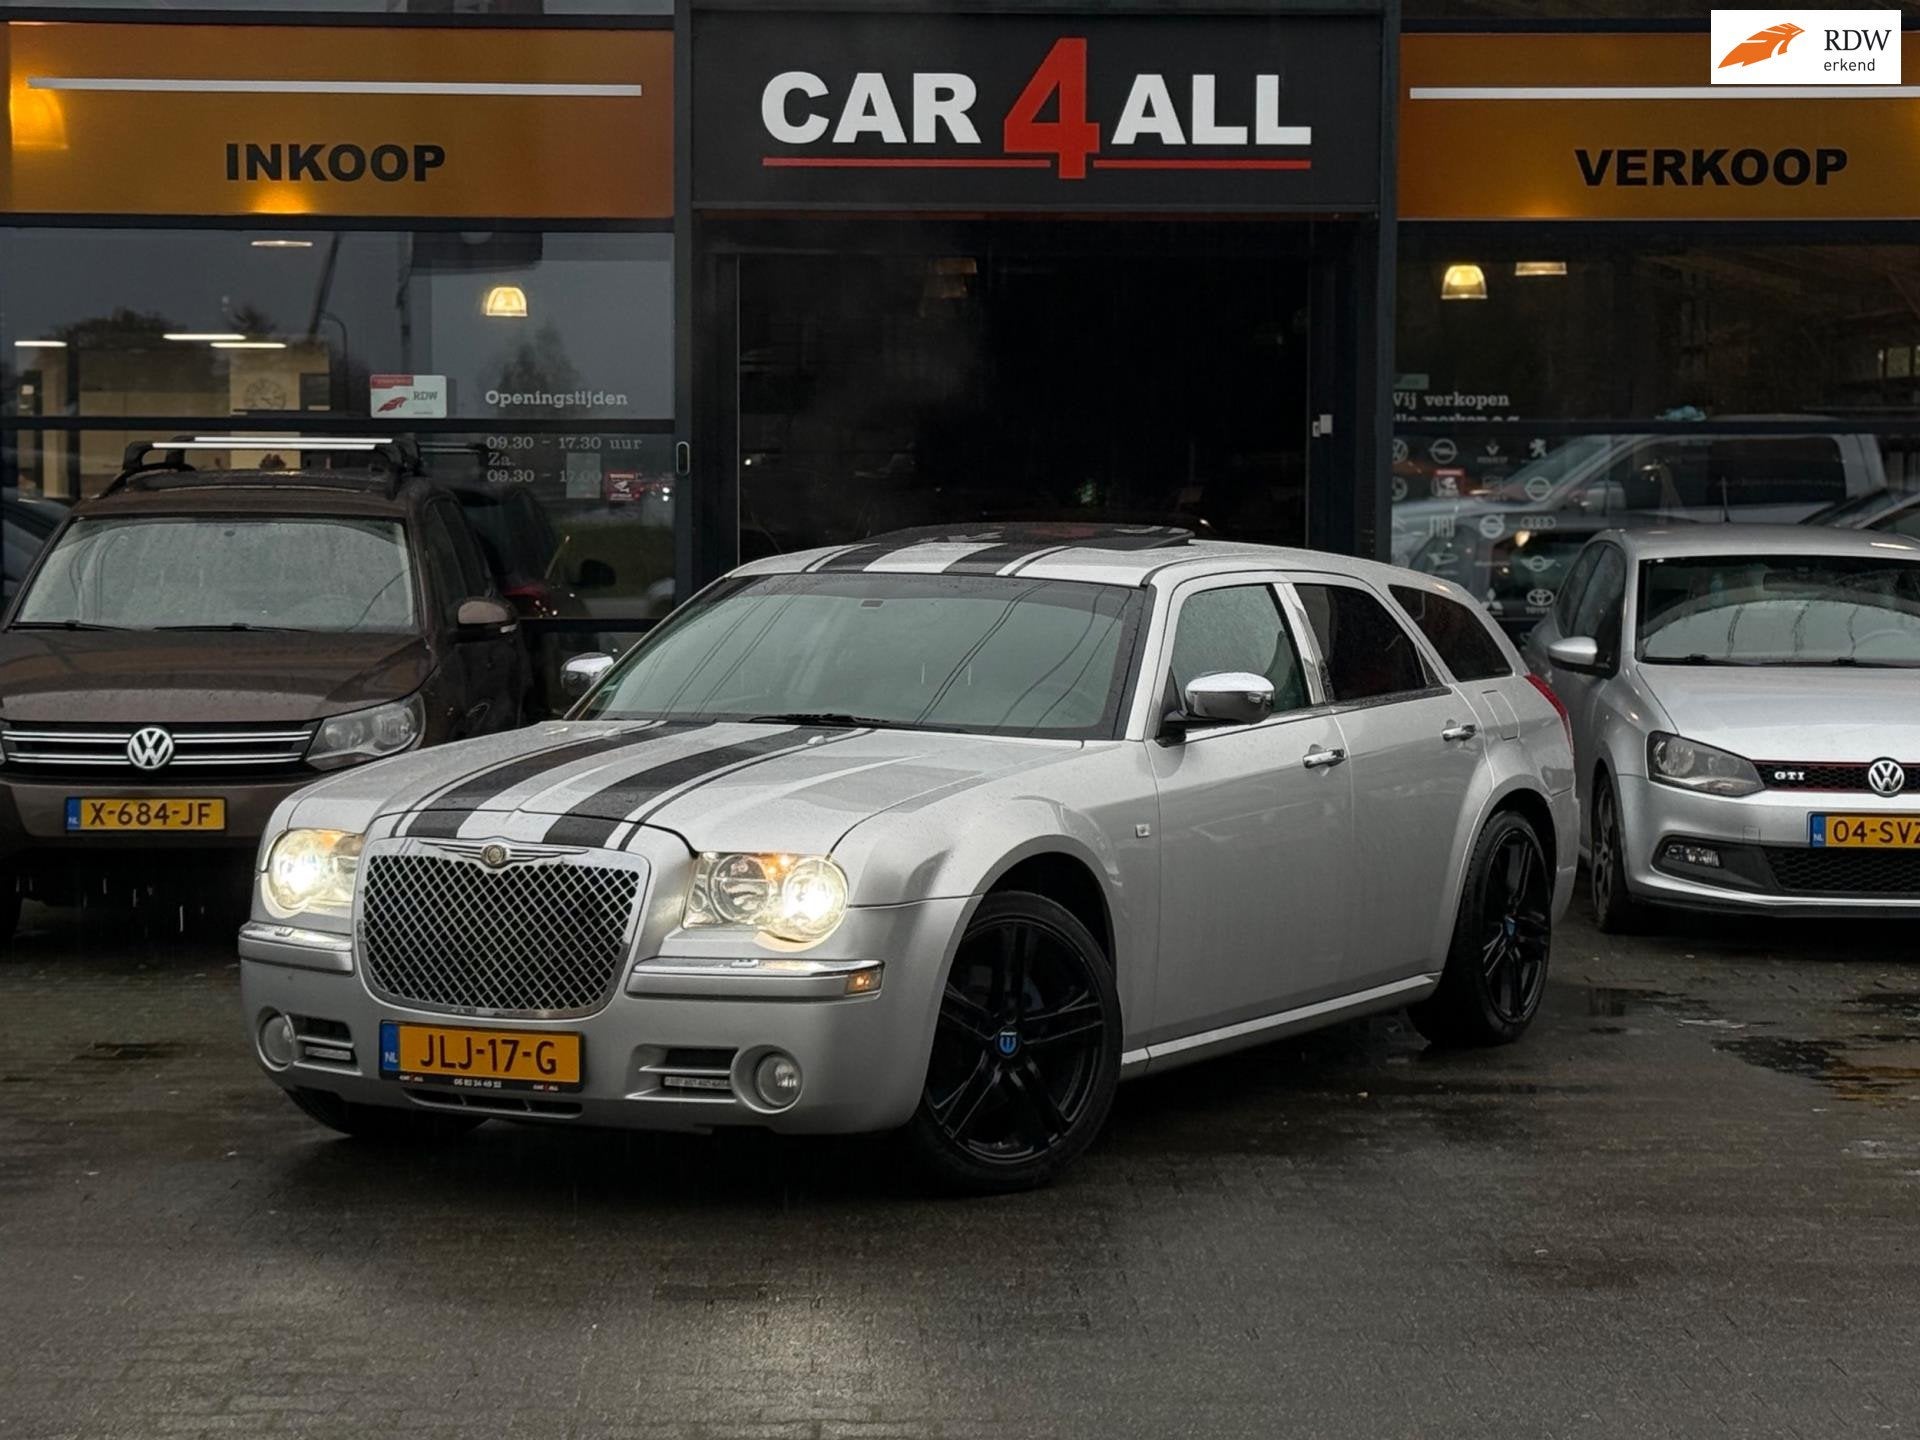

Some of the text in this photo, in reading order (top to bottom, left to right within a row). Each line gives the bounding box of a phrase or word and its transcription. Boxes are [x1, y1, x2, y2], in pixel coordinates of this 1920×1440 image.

[761, 37, 1312, 179] CAR 4 ALL
[226, 143, 445, 182] INKOOP
[1574, 148, 1848, 187] VERKOOP
[485, 390, 628, 408] Openingstijden
[1424, 391, 1511, 410] verkopen
[486, 436, 534, 450] 09.30
[559, 436, 601, 450] 17.30
[609, 439, 643, 450] uur
[487, 469, 535, 482] 09.30
[1774, 771, 1805, 781] GTI
[90, 803, 212, 826] X-684-JF
[1813, 834, 1824, 842] NL
[384, 1034, 557, 1075] NL JLJ-17-G
